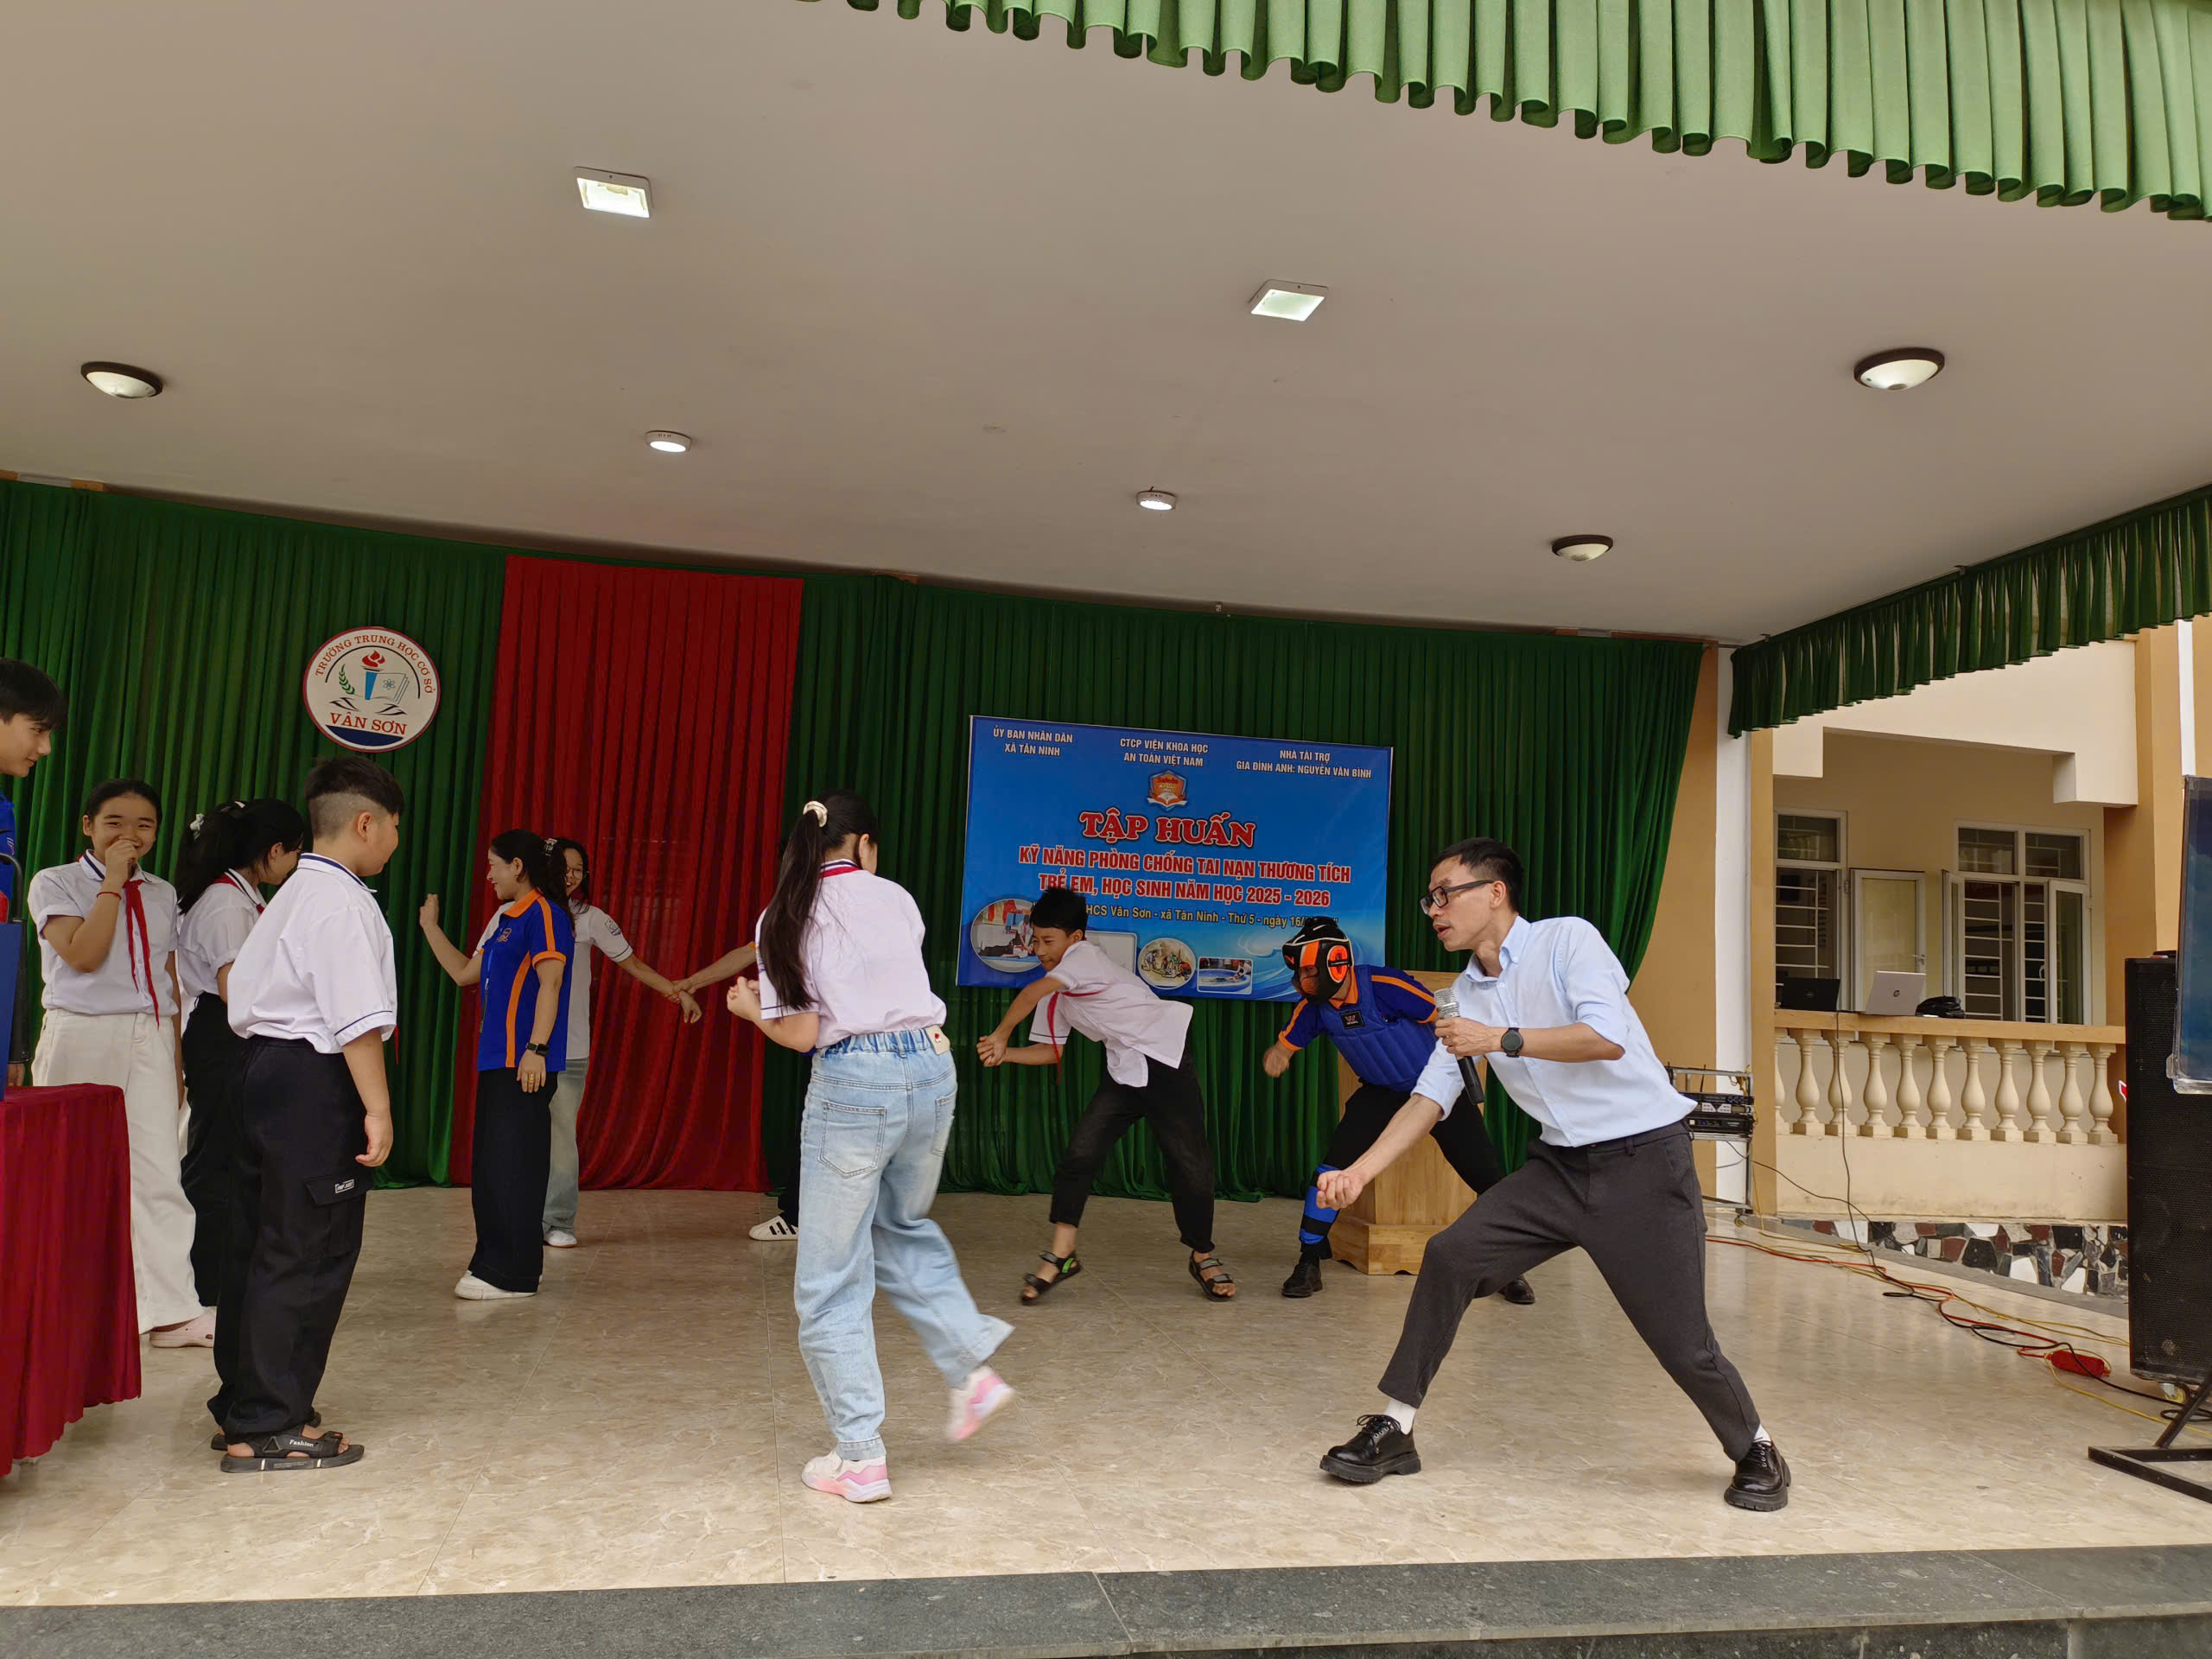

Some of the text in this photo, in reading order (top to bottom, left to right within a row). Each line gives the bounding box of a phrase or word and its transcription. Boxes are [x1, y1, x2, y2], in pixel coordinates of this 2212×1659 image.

[315, 635, 436, 694] TRƯỜNG TRUNG HỌC CƠ SỞ
[329, 712, 408, 735] VÂN SƠN
[1007, 729, 1025, 740] BAN
[1027, 730, 1052, 741] NHÂN
[1055, 732, 1072, 743] DÂN
[1120, 738, 1208, 754] CTCP VIỆN KHOA HỌC
[1005, 742, 1060, 756] XÃ TÂN NINH
[1124, 753, 1204, 766] AN TOÀN VIỆT NAM
[1280, 749, 1331, 764] NHÀ TÀI TRỢ
[1236, 761, 1250, 770] GIA
[1253, 760, 1273, 772] ĐÌNH
[1275, 764, 1295, 773] ANH:
[1298, 763, 1331, 776] NGUYỄN
[1352, 768, 1371, 779] BÌNH
[1079, 807, 1255, 848] TẬP HUẤN
[1019, 843, 1351, 883] KỸ NĂNG PHÒNG CHỐNG TAI NẠN THƯƠNG TÍCH
[1039, 868, 1067, 891] TRẺ
[1071, 874, 1098, 896] EM,
[1102, 877, 1132, 899] HỌC
[1135, 880, 1172, 899] SINH
[1175, 879, 1210, 900] NĂM
[1213, 884, 1243, 906] HỌC
[1246, 887, 1281, 905] 2025
[1294, 889, 1331, 907] 2026
[1085, 905, 1108, 916] HCS
[1110, 906, 1129, 917] Vân
[1132, 906, 1151, 919] Sơn
[1160, 910, 1172, 919] xã
[1175, 910, 1193, 921] Tân
[1196, 911, 1218, 922] Ninh
[1228, 912, 1247, 925] Thứ
[1249, 914, 1255, 925] 5
[1263, 916, 1287, 928] ngày
